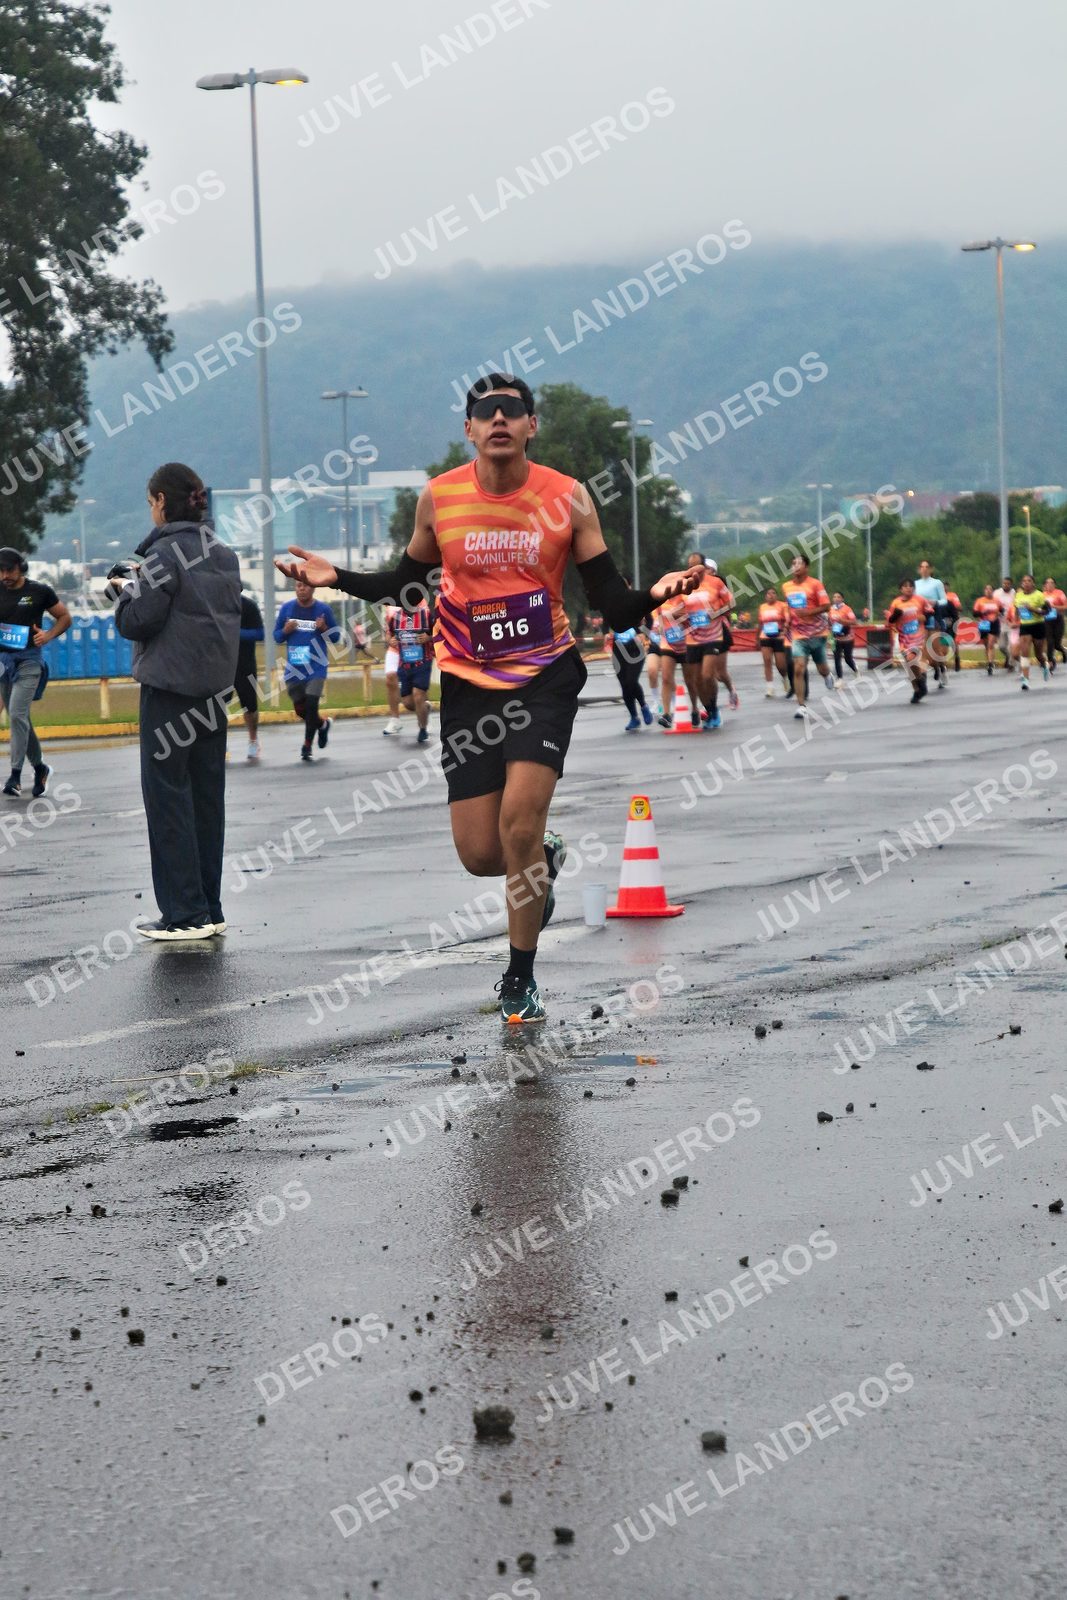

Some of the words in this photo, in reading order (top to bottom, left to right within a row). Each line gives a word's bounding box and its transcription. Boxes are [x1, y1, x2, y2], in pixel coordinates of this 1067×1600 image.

[464, 530, 540, 551] CARRERA
[465, 551, 524, 565] OMNILIFE
[472, 602, 507, 615] CARRERA
[473, 612, 500, 622] OMNILIFE
[490, 618, 529, 640] 816
[2, 632, 21, 642] 2811
